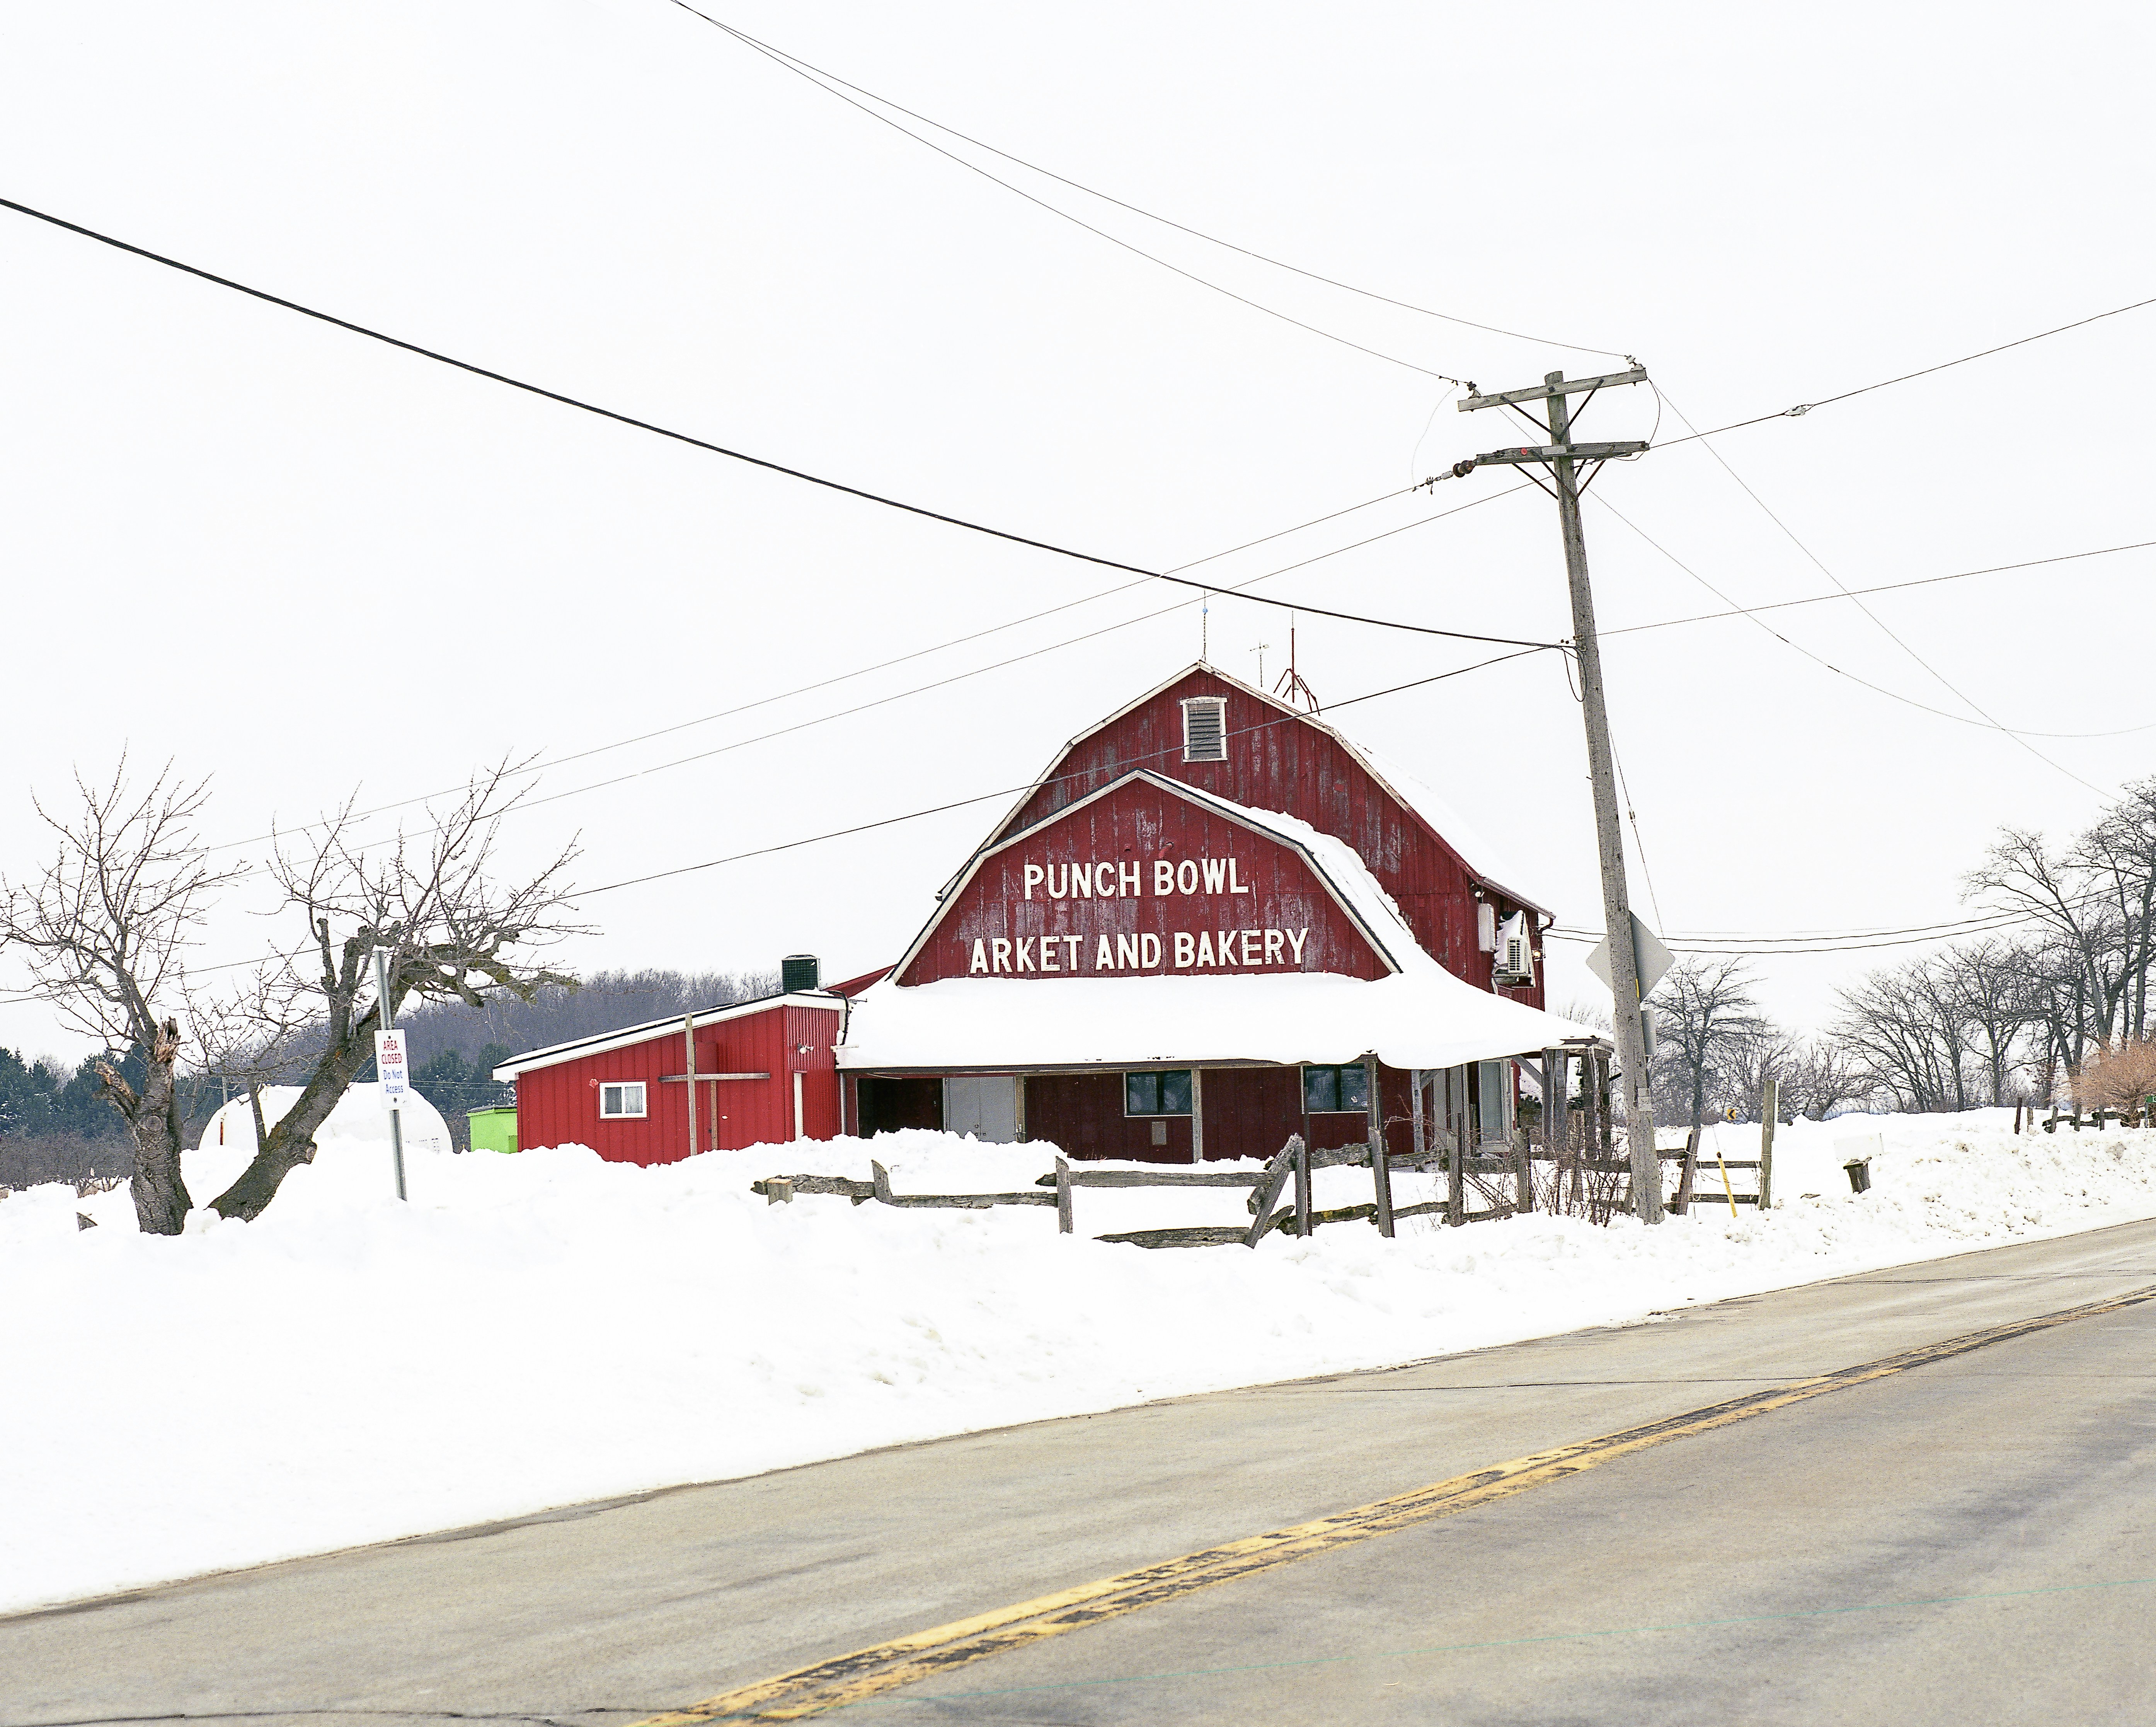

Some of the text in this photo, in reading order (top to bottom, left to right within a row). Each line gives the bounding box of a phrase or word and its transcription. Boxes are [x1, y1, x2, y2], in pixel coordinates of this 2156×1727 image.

[1024, 858, 1249, 900] PUNCH BOWL
[970, 927, 1309, 973] ARKET AND BAKERY
[383, 1040, 398, 1050] AREA
[381, 1053, 402, 1064] CLOSED
[383, 1069, 403, 1080] Do Not
[385, 1084, 404, 1094] Access
